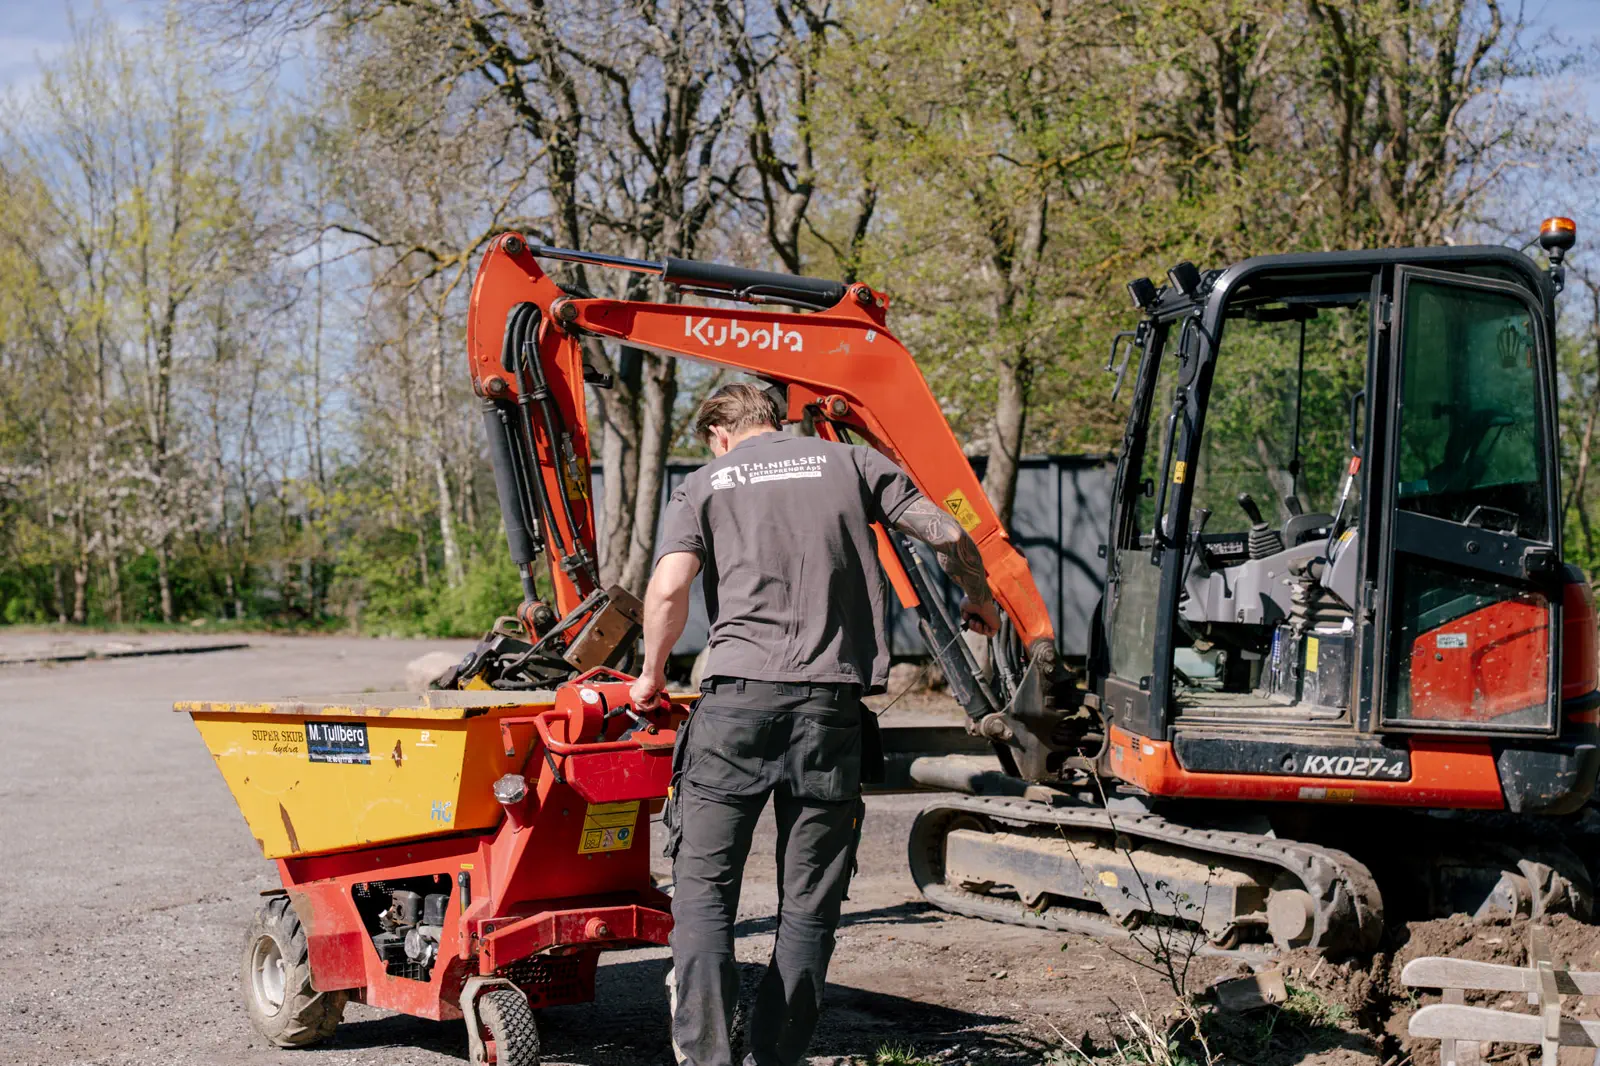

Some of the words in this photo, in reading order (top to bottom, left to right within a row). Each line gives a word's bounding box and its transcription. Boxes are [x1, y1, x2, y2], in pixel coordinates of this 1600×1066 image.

[685, 315, 803, 352] Kubota
[741, 455, 827, 472] T.H.NIELSEN
[252, 730, 279, 741] SUPER
[280, 731, 304, 742] SKUB
[308, 724, 321, 740] M.
[321, 724, 364, 746] Tullberg
[273, 743, 299, 754] hydra
[1302, 755, 1404, 777] KX027-4
